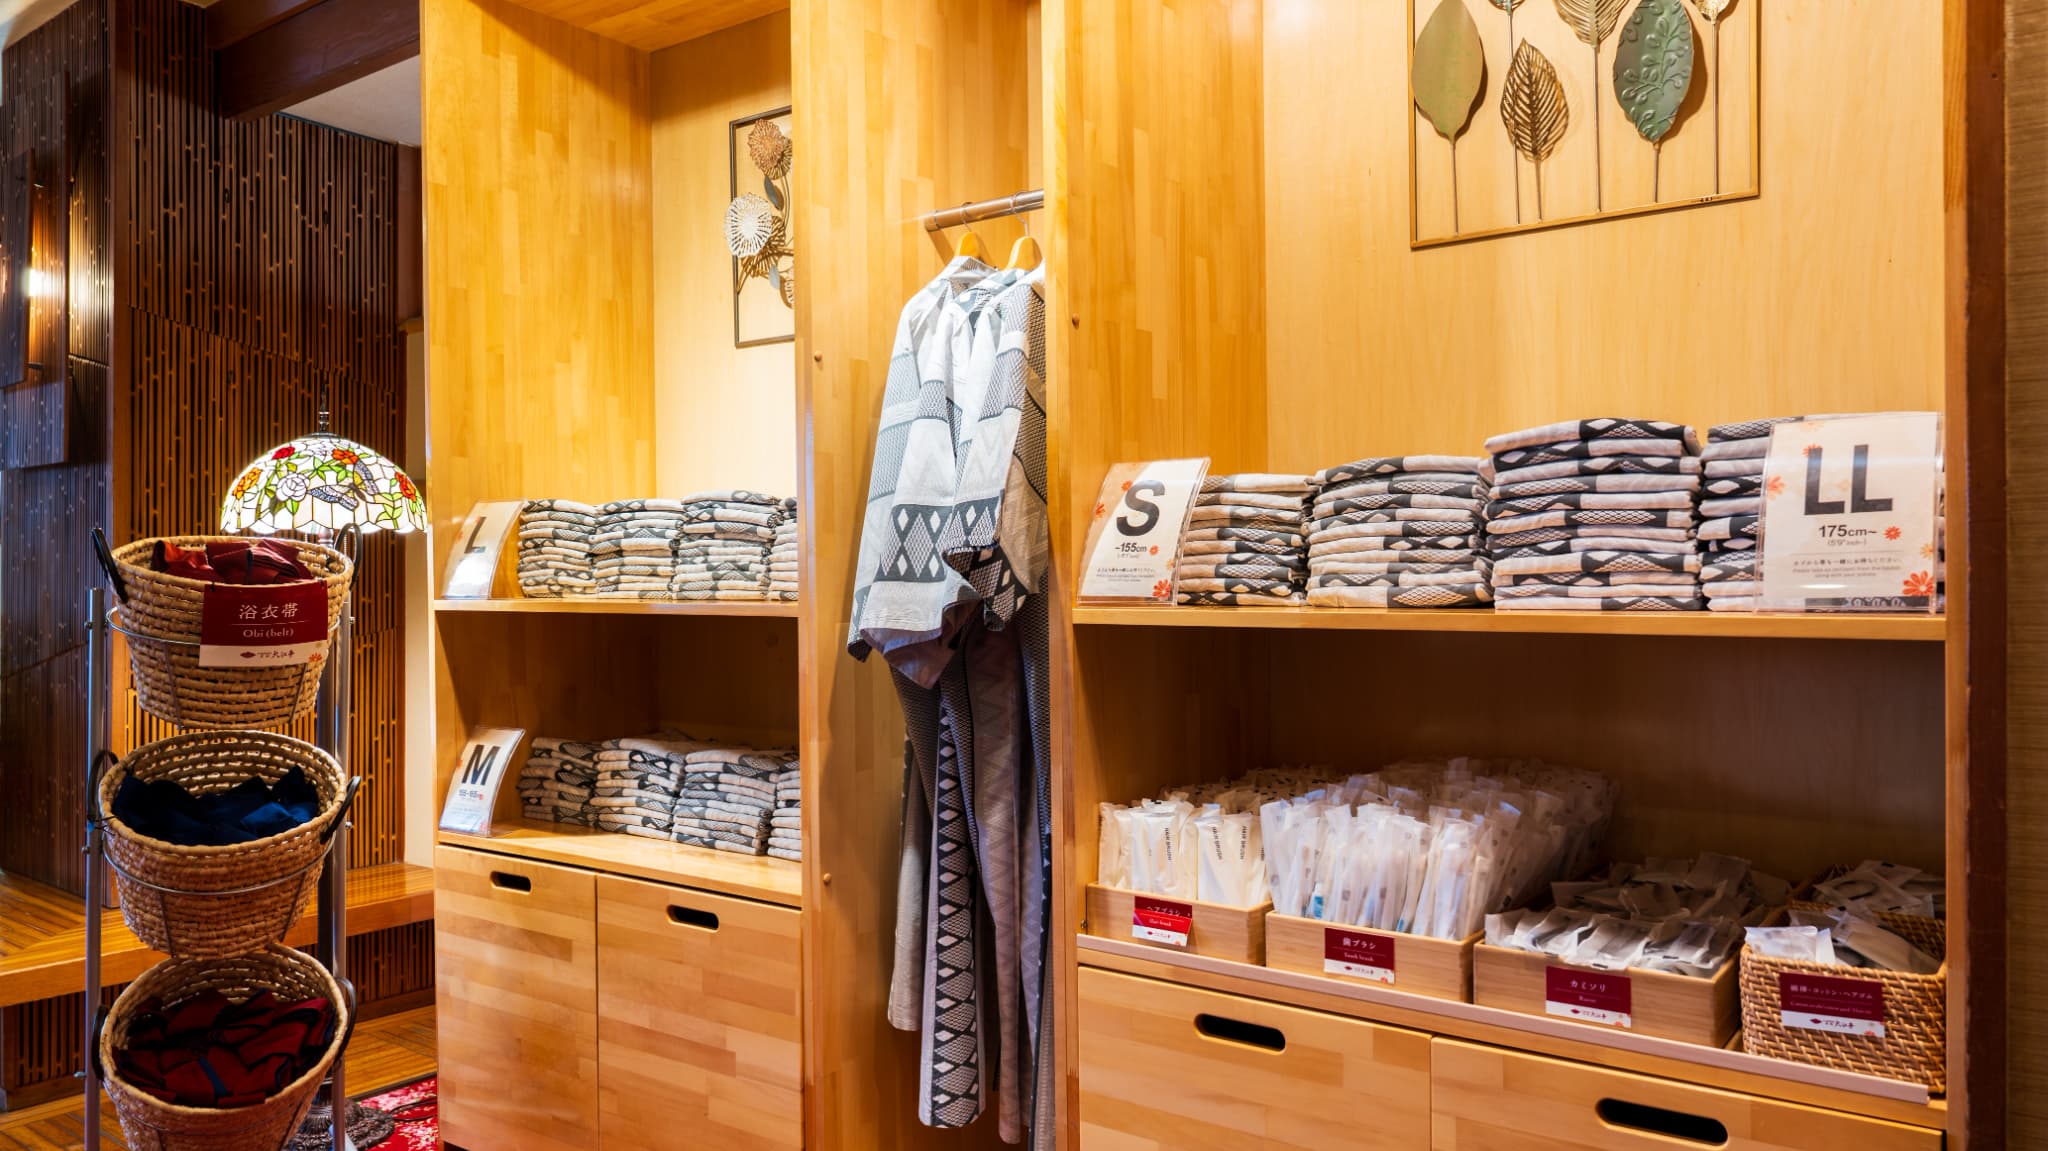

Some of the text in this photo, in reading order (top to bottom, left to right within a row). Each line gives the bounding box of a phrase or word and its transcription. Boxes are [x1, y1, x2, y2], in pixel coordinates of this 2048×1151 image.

[1804, 444, 1893, 516] LL
[1116, 480, 1166, 537] S
[464, 516, 487, 554] L
[239, 602, 299, 620] 浴衣帯
[243, 627, 294, 639] Obi (belt)
[461, 744, 500, 786] M
